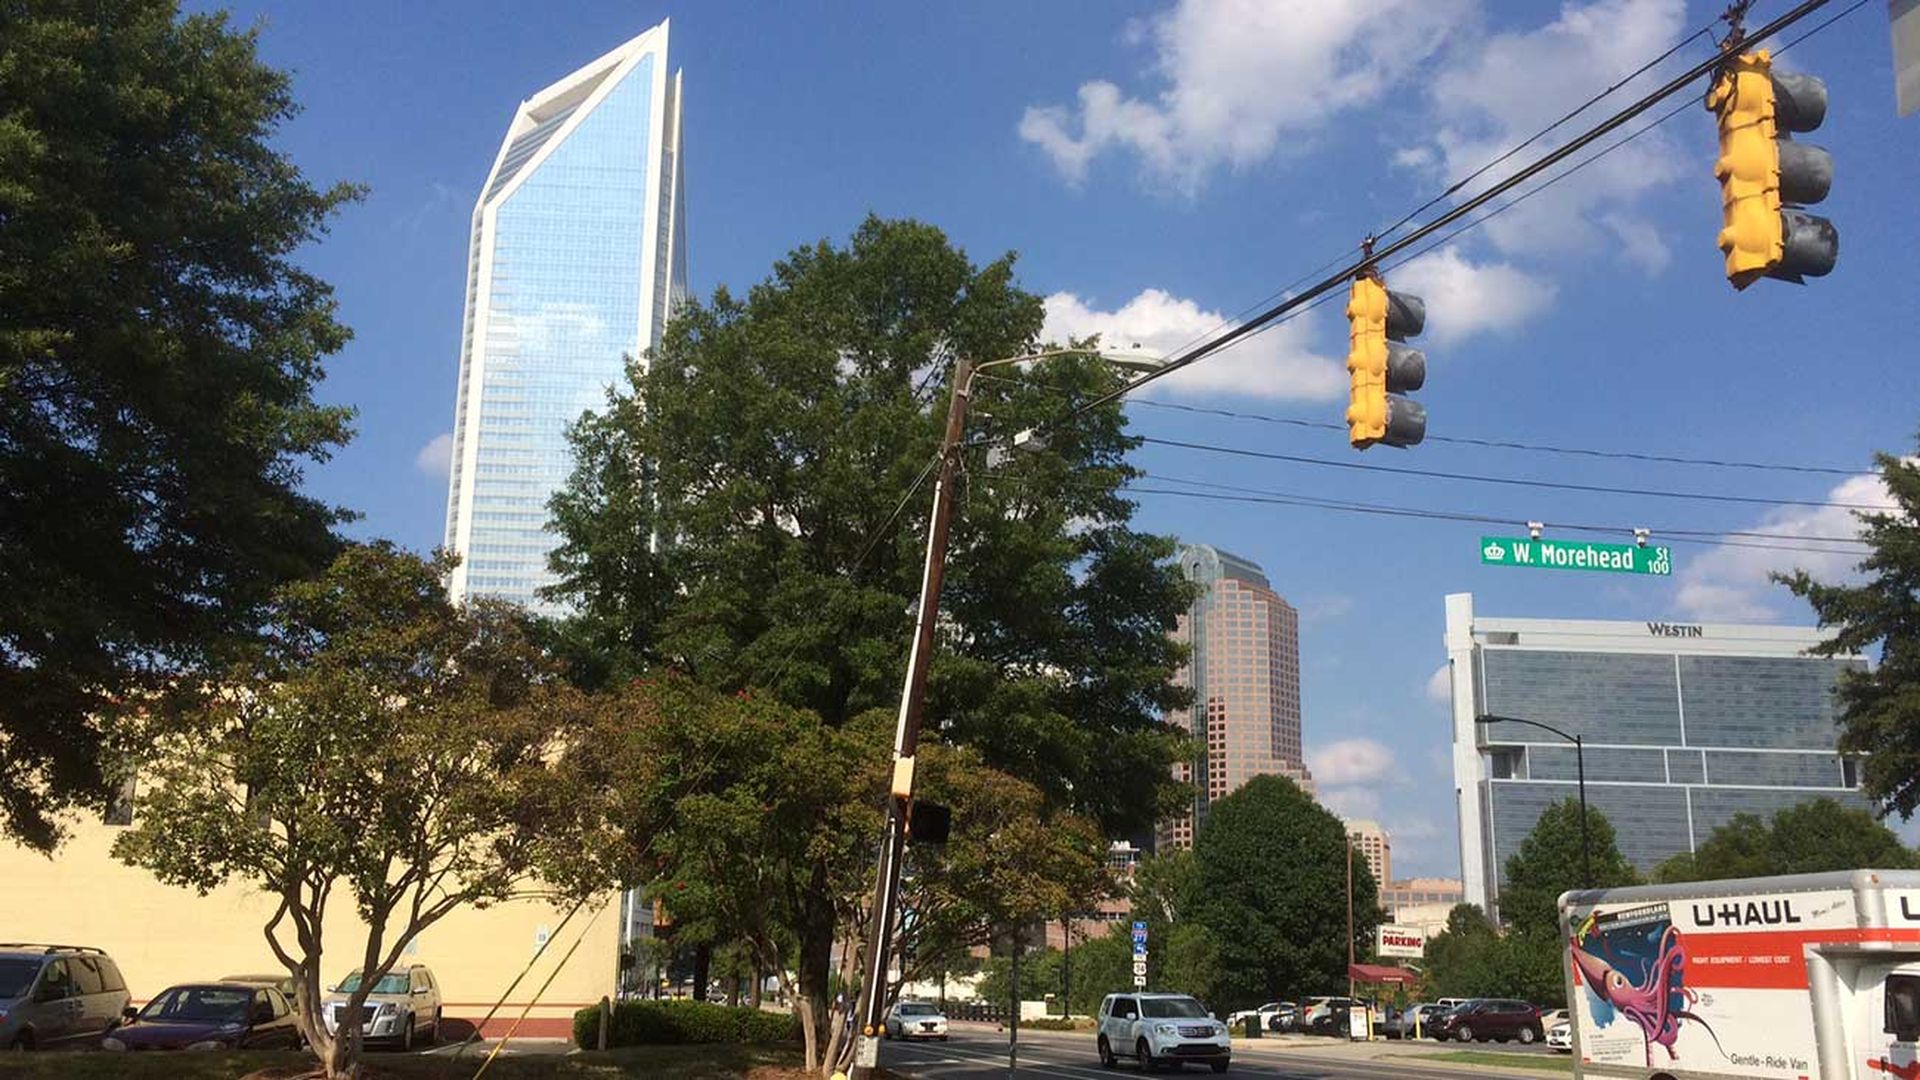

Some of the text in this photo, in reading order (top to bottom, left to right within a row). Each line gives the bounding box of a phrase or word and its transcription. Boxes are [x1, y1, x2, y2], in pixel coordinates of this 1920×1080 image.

[1512, 543, 1669, 570] W. Morehead St
[1647, 560, 1670, 574] 100
[1692, 900, 1802, 927] U-HAUL
[1382, 935, 1422, 948] PARKING
[1789, 1057, 1808, 1070] Van
